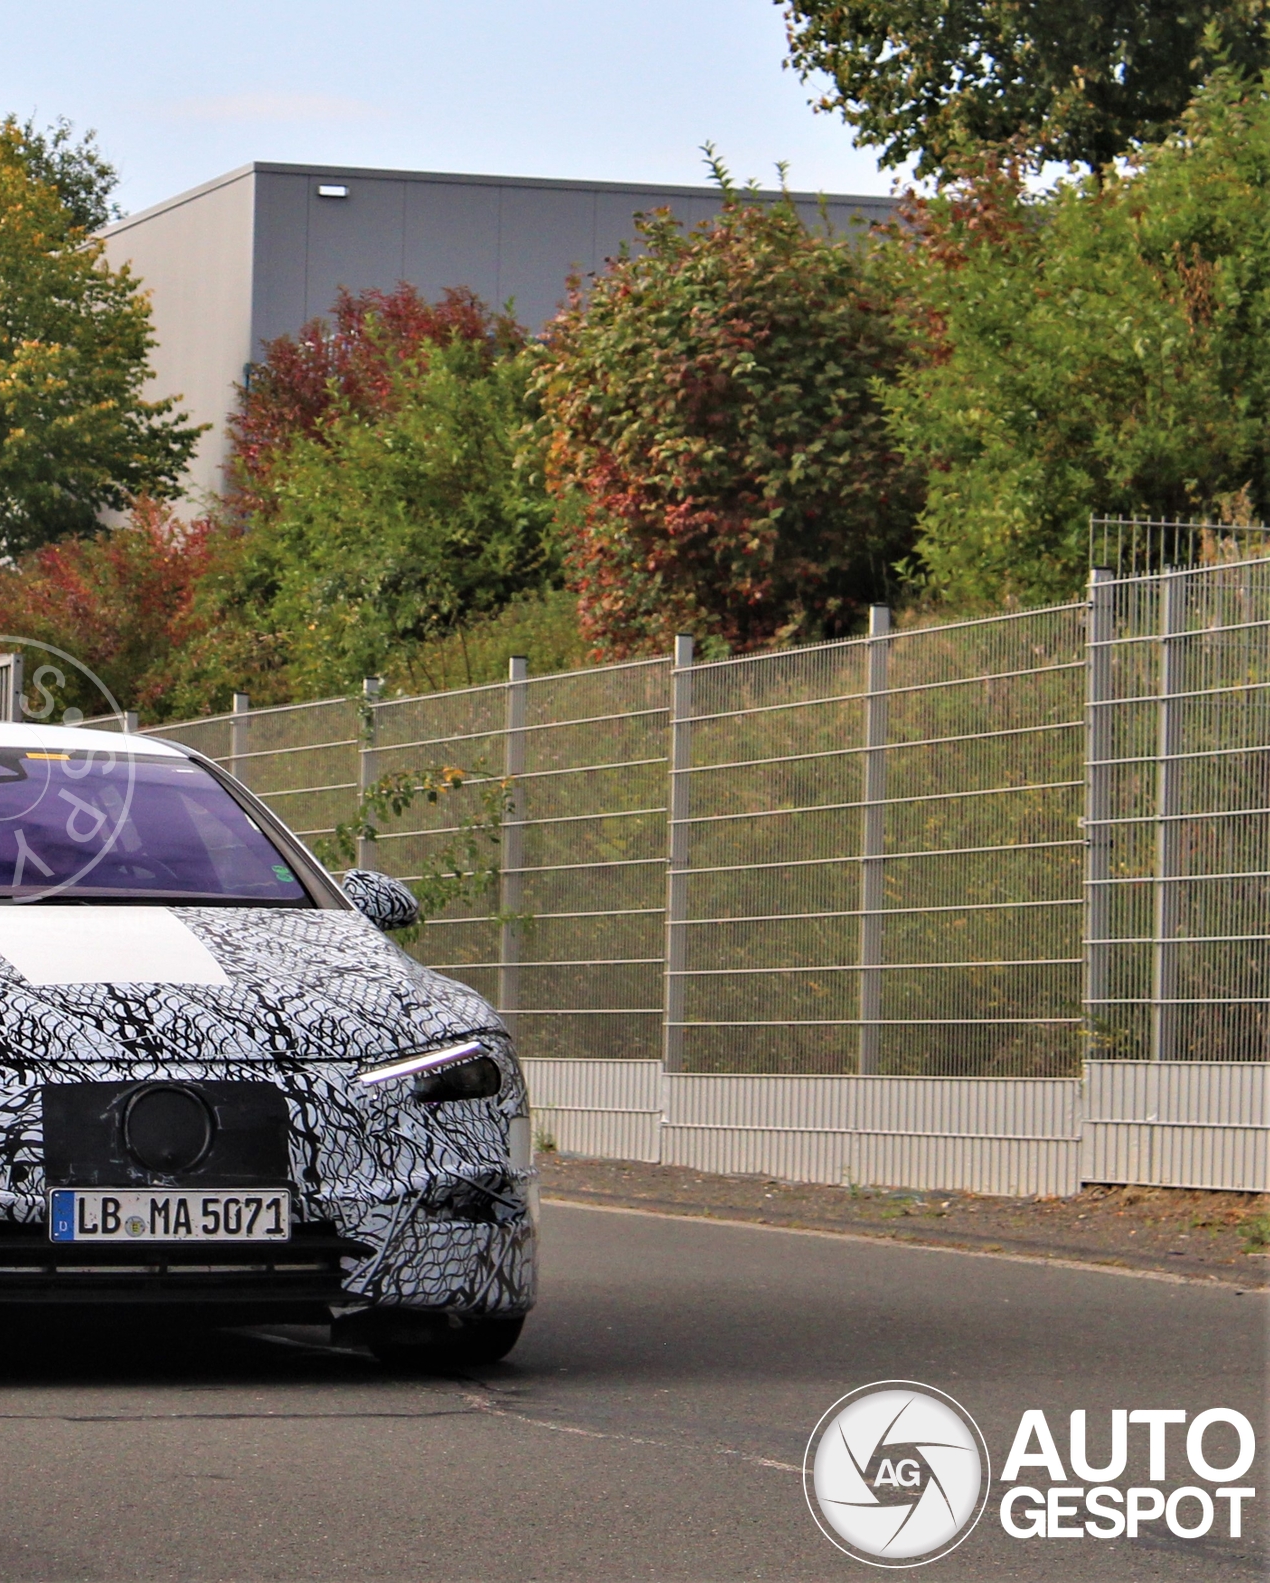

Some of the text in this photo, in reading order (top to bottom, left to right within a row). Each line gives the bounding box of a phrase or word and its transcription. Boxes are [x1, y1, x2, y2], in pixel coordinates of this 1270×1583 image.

[78, 1196, 121, 1235] LB
[150, 1196, 192, 1235] MA
[202, 1196, 283, 1235] 5071
